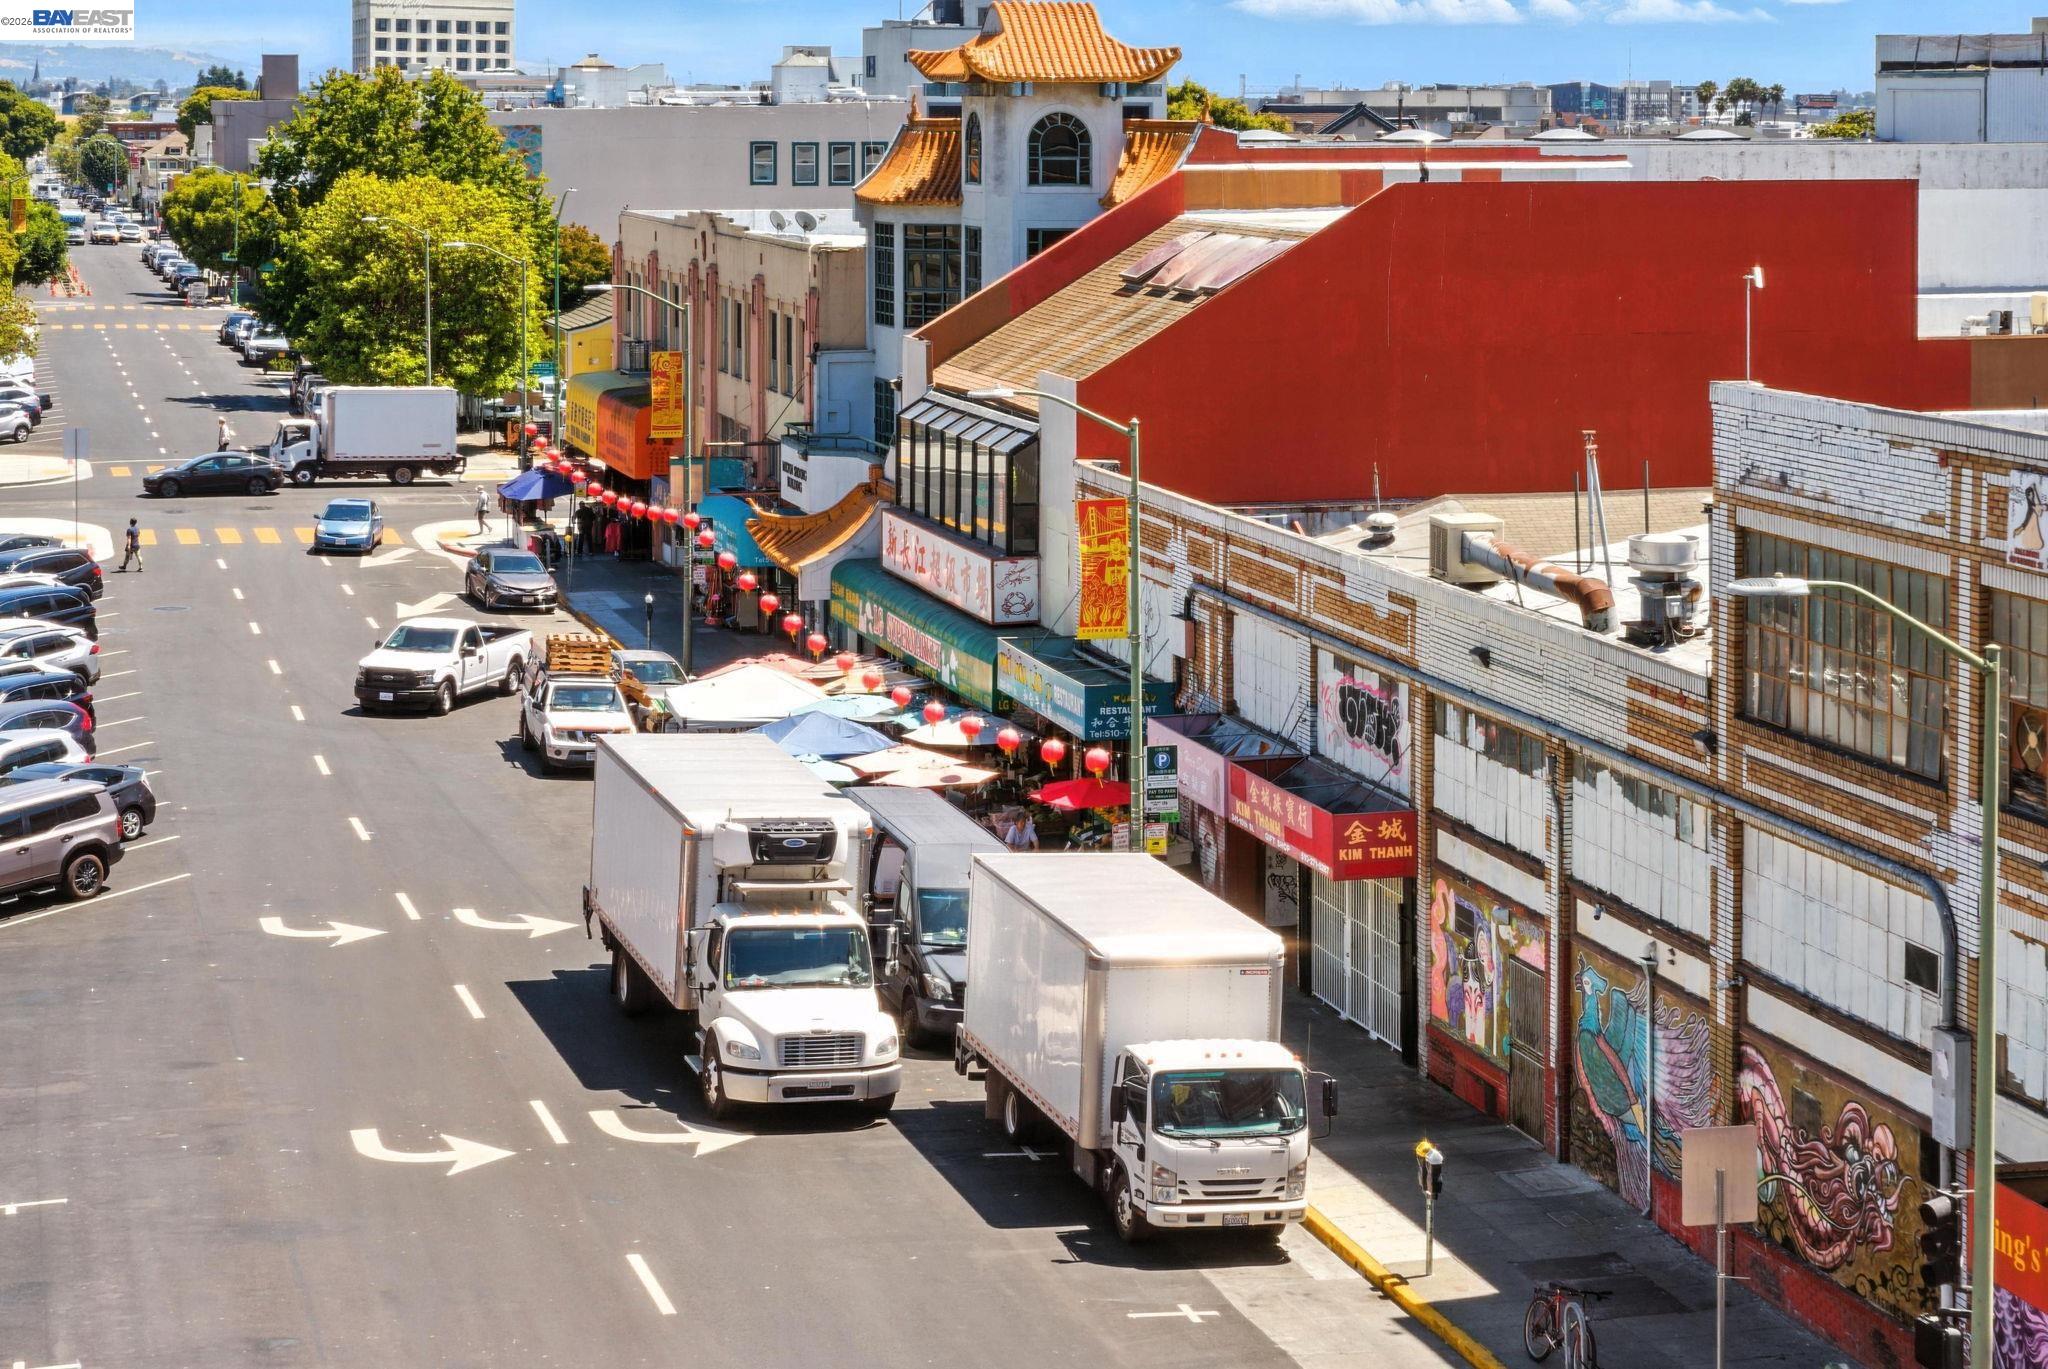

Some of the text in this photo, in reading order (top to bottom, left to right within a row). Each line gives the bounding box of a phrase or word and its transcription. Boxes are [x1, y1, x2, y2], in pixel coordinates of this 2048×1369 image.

[1235, 800, 1281, 837] KIM THANH
[1344, 818, 1406, 845] 金城
[1339, 846, 1412, 861] KIM THANH
[1994, 1218, 2041, 1273] ing's
